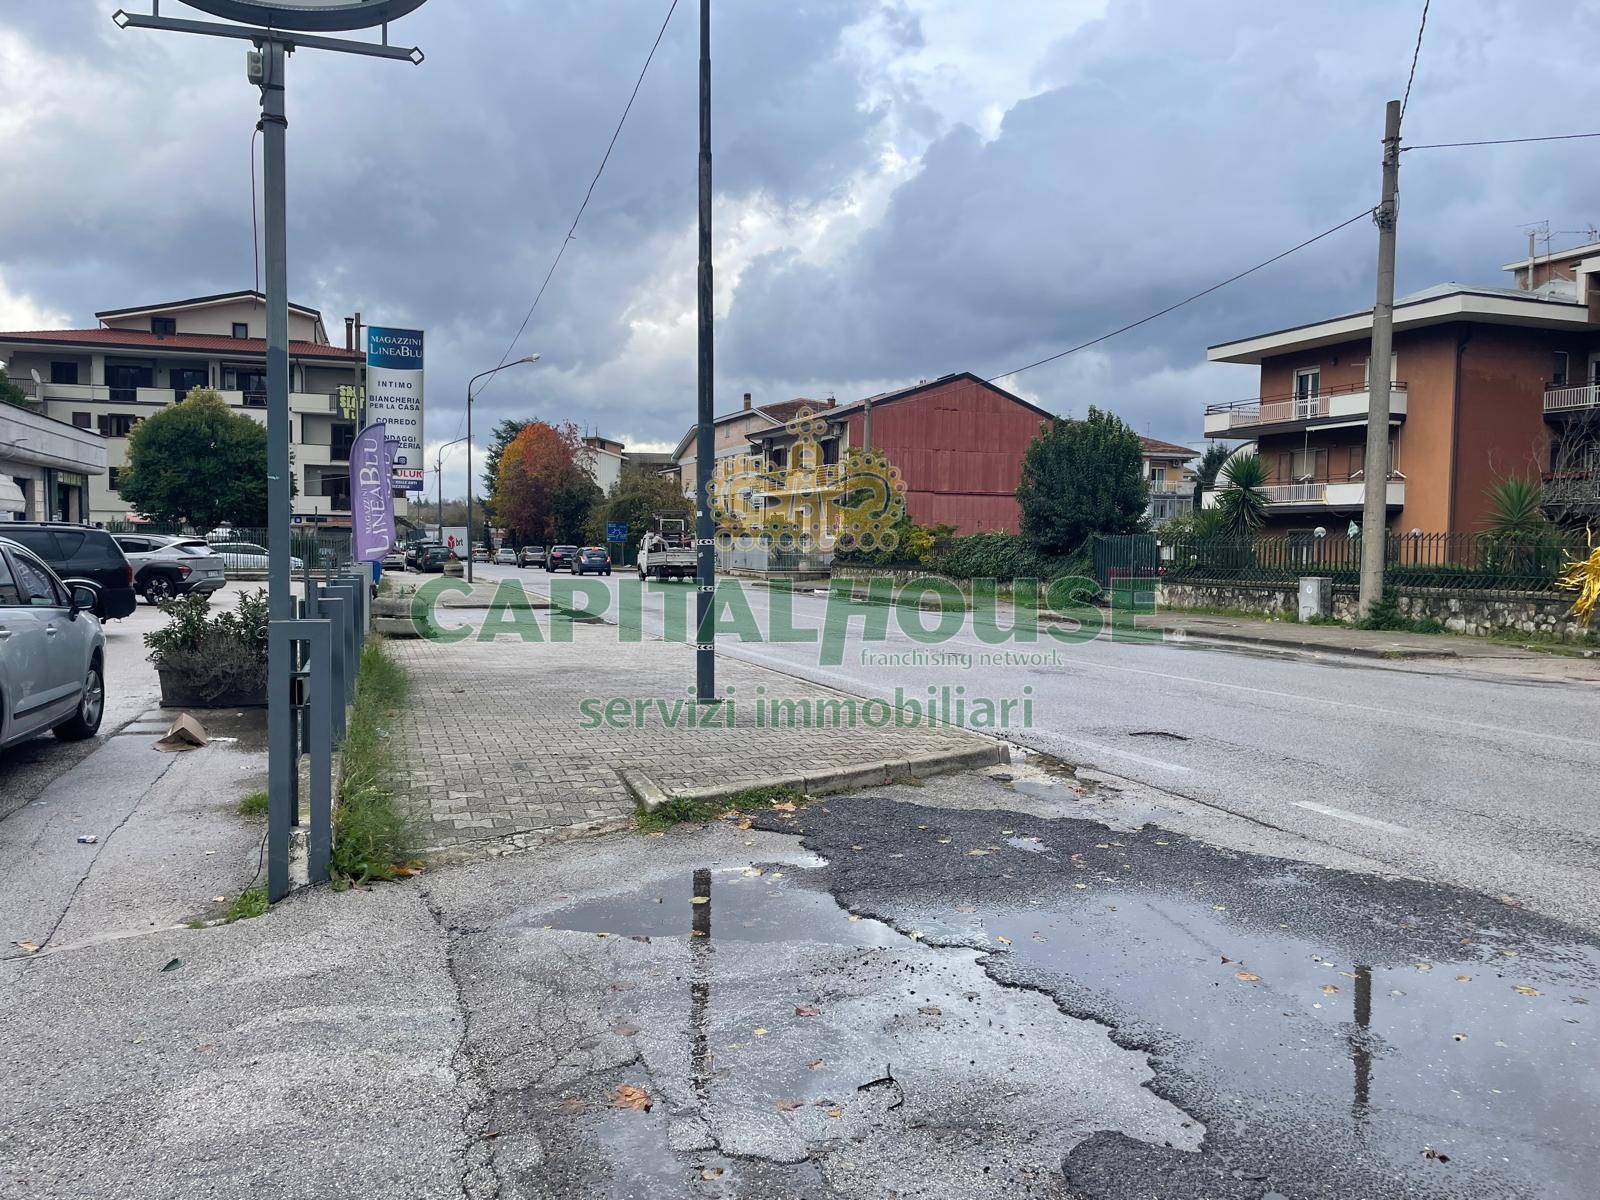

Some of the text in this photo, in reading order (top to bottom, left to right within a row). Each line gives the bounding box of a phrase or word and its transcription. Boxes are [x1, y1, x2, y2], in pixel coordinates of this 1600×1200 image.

[371, 335, 421, 346] MAGAZZINI
[377, 381, 412, 389] INTIMO
[369, 395, 420, 405] BIANCHERIA
[376, 417, 417, 426] CORREDO
[384, 434, 416, 443] NDAGGI
